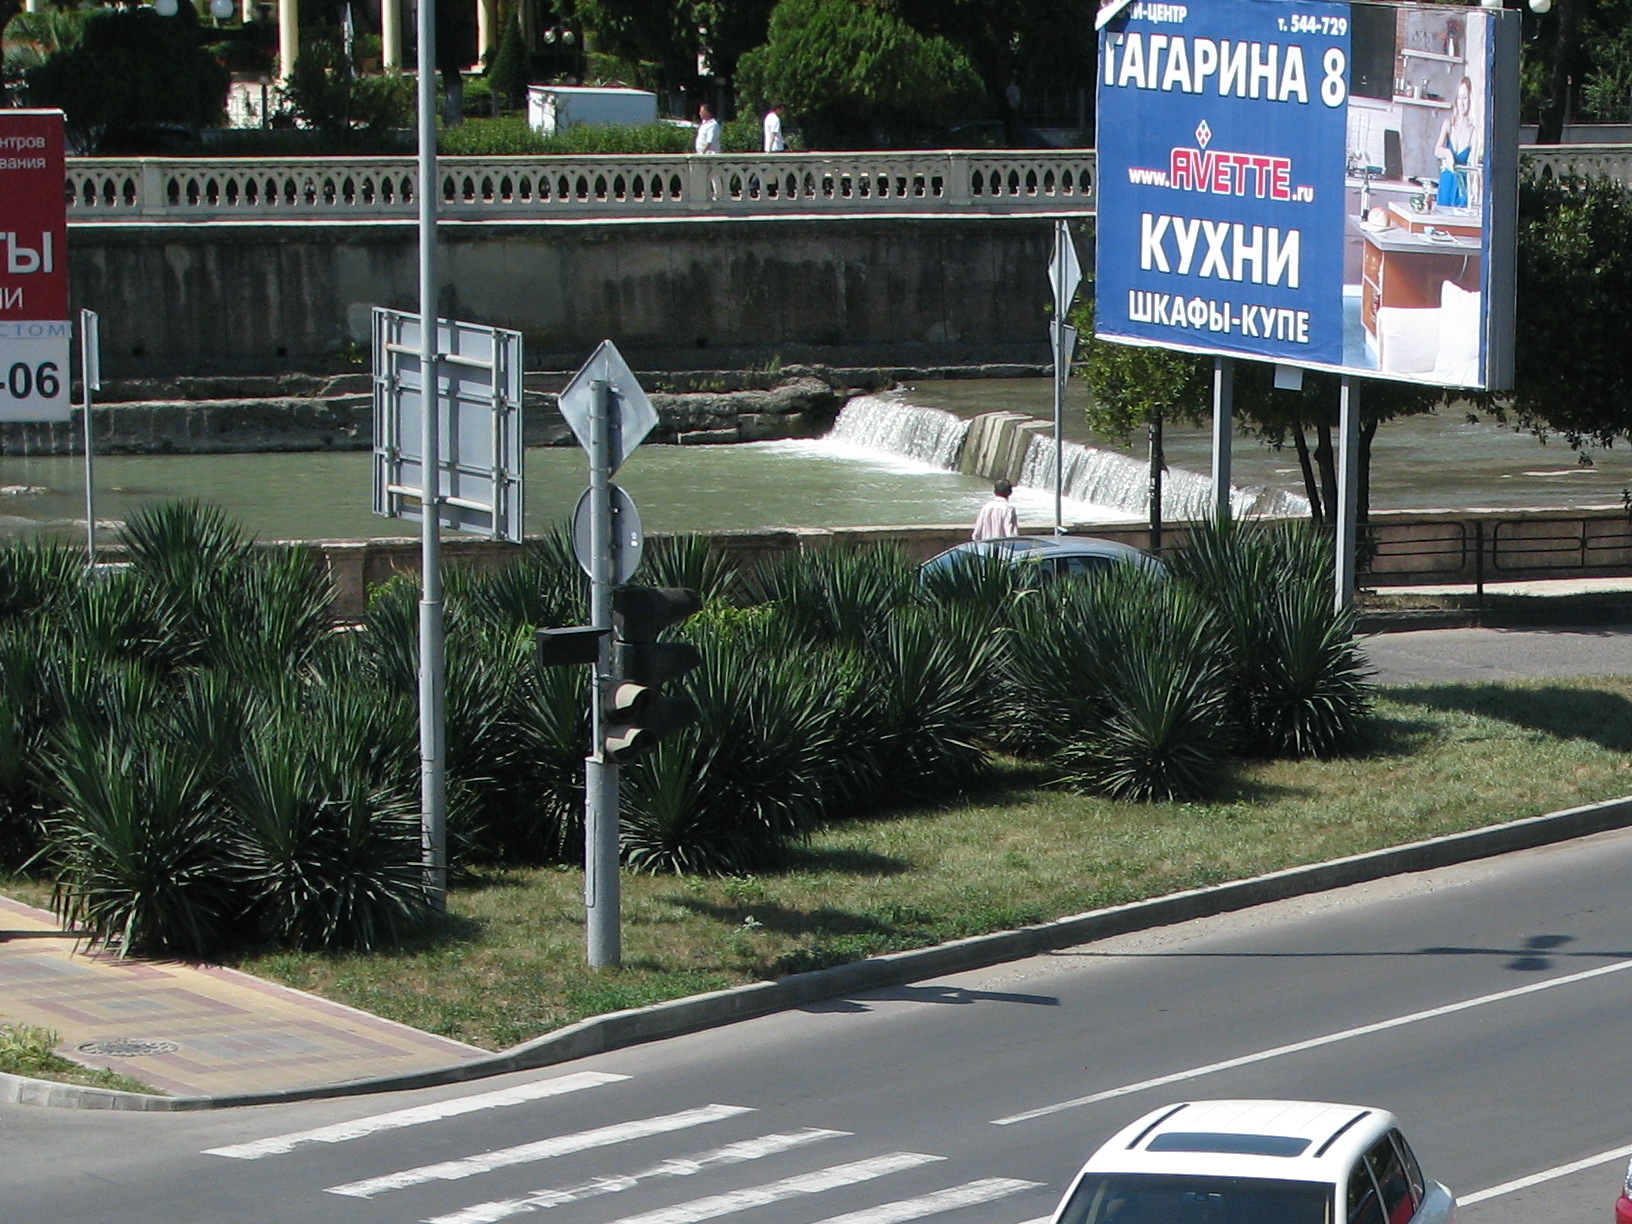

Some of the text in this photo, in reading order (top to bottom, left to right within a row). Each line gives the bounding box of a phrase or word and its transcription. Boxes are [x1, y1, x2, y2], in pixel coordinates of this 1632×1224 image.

[1290, 15, 1347, 36] 544-729
[1104, 32, 1347, 107] ГАГАРИНА 8
[1140, 213, 1300, 289] КУХНИ
[1128, 290, 1310, 344] ШКАФЫ-КУПЕ
